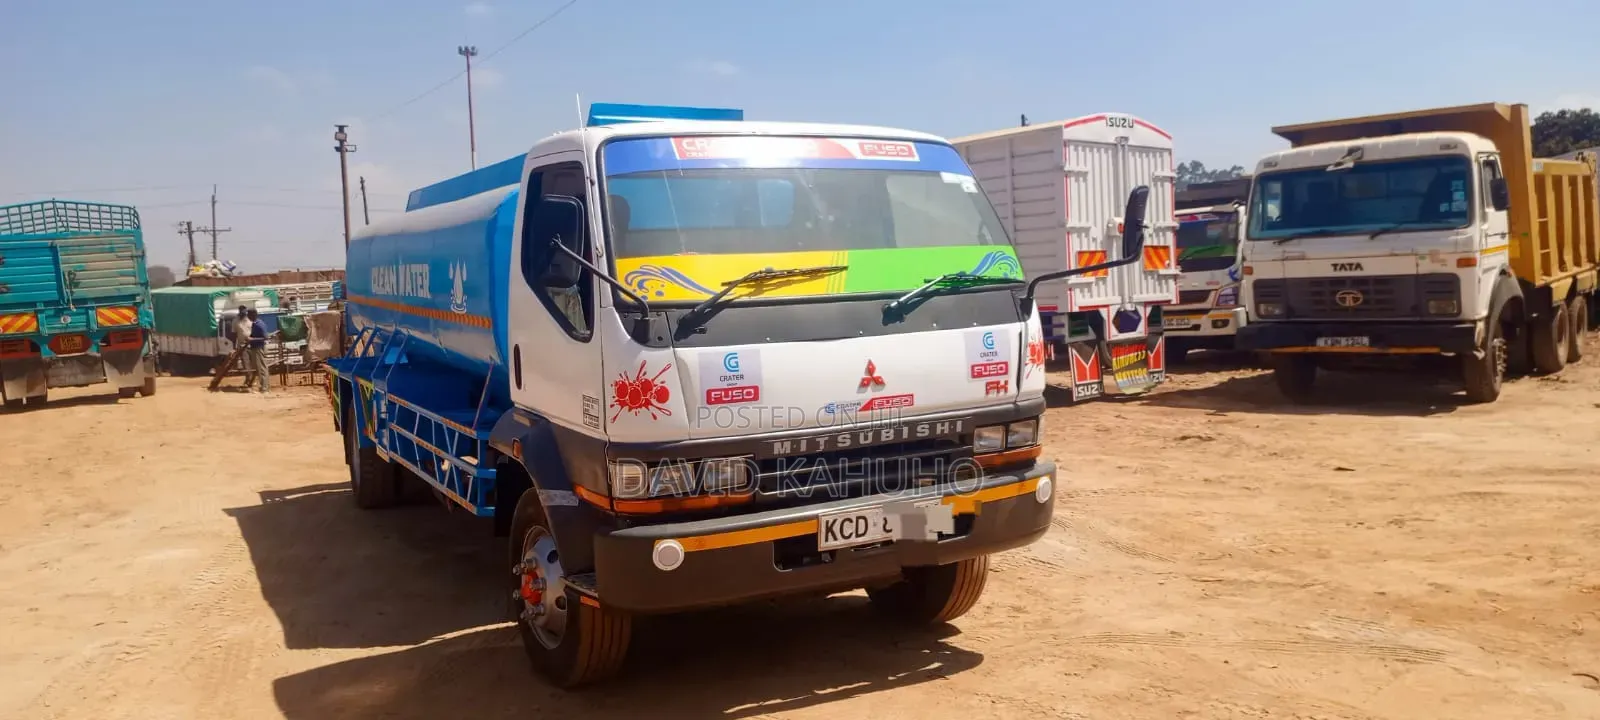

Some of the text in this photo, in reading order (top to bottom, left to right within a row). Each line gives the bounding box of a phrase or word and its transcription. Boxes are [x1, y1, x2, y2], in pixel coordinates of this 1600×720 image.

[1105, 116, 1134, 129] ISUZU
[863, 143, 909, 156] FUSO
[1330, 262, 1364, 272] TATA
[371, 263, 431, 299] CLEAN WATER
[973, 363, 1006, 376] FUSO
[719, 374, 744, 382] CRATER
[711, 388, 755, 402] FUSO
[1075, 384, 1104, 397] ISUZU
[875, 397, 911, 407] FUSO
[773, 420, 963, 456] MITSUBISHI
[824, 515, 869, 543] KCD
